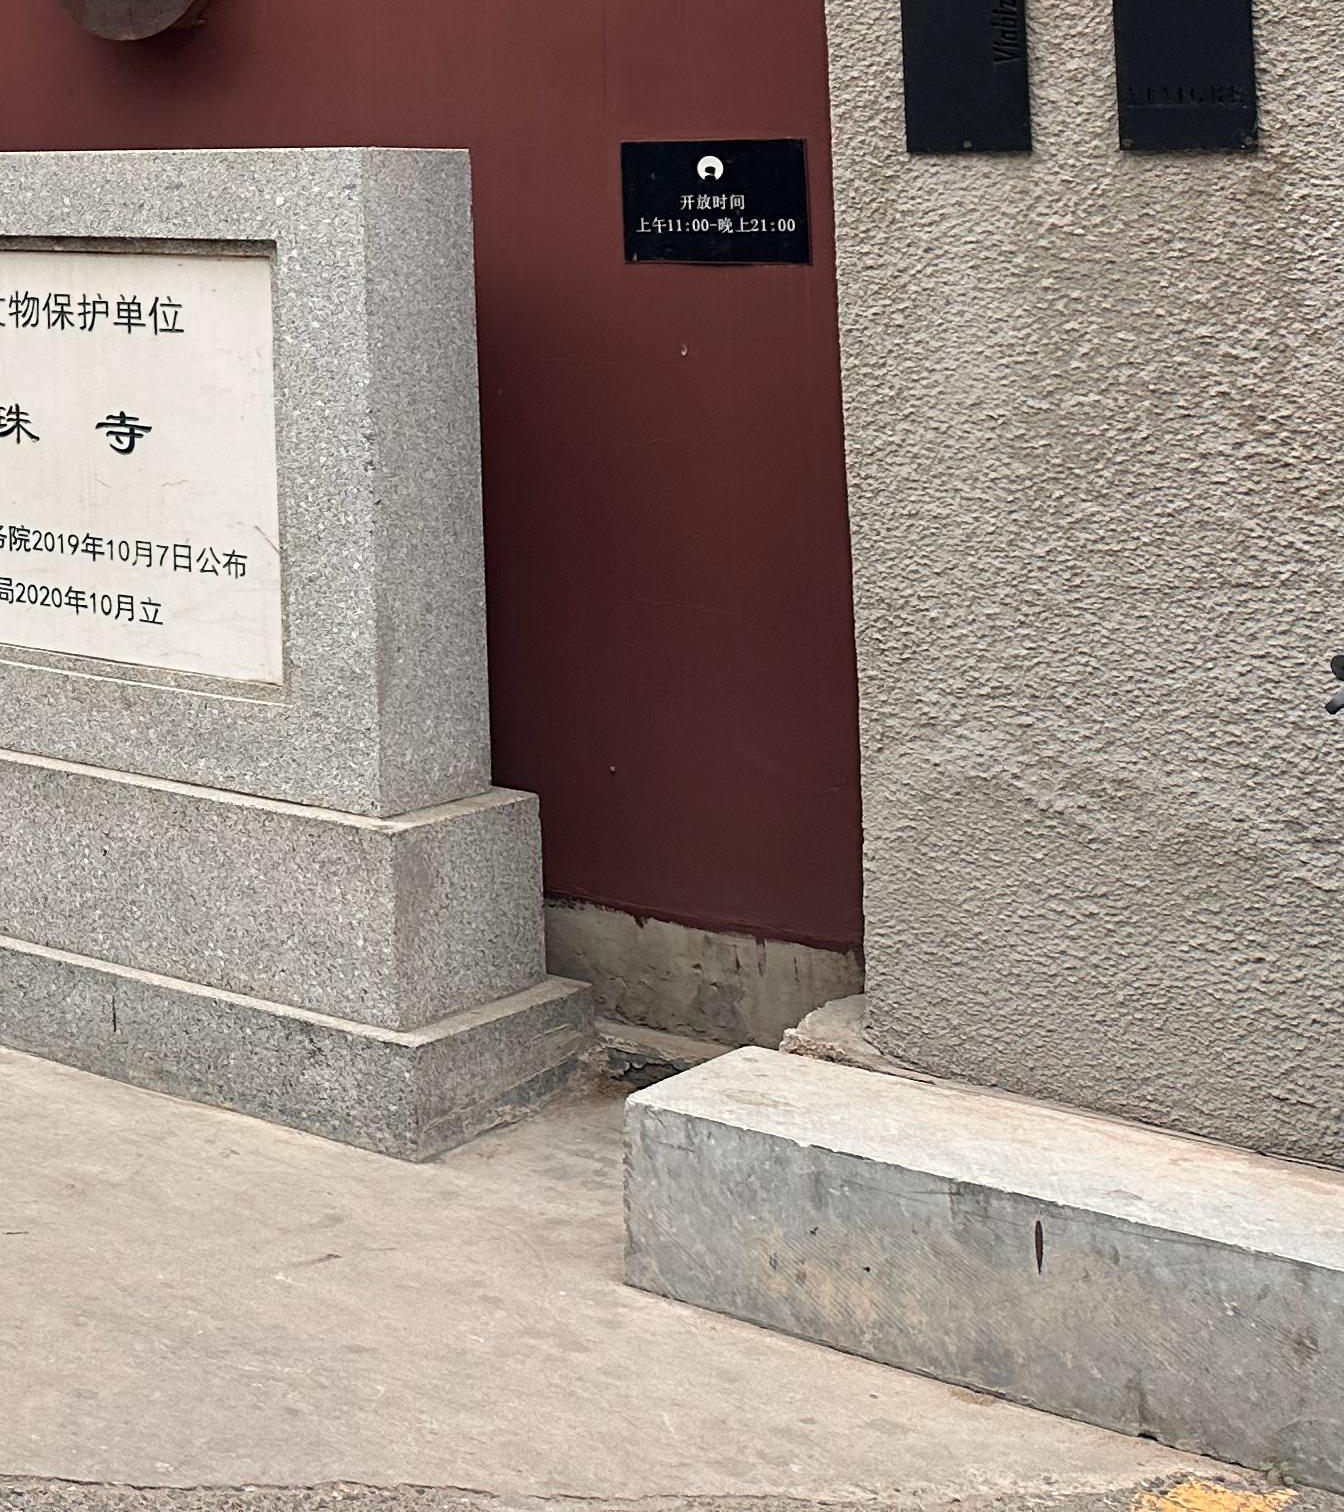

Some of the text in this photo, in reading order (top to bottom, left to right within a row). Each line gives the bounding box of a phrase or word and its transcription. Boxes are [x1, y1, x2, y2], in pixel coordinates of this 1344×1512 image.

[679, 194, 745, 211] 开放时间
[635, 217, 796, 233] 上午11:00-晚上21:00
